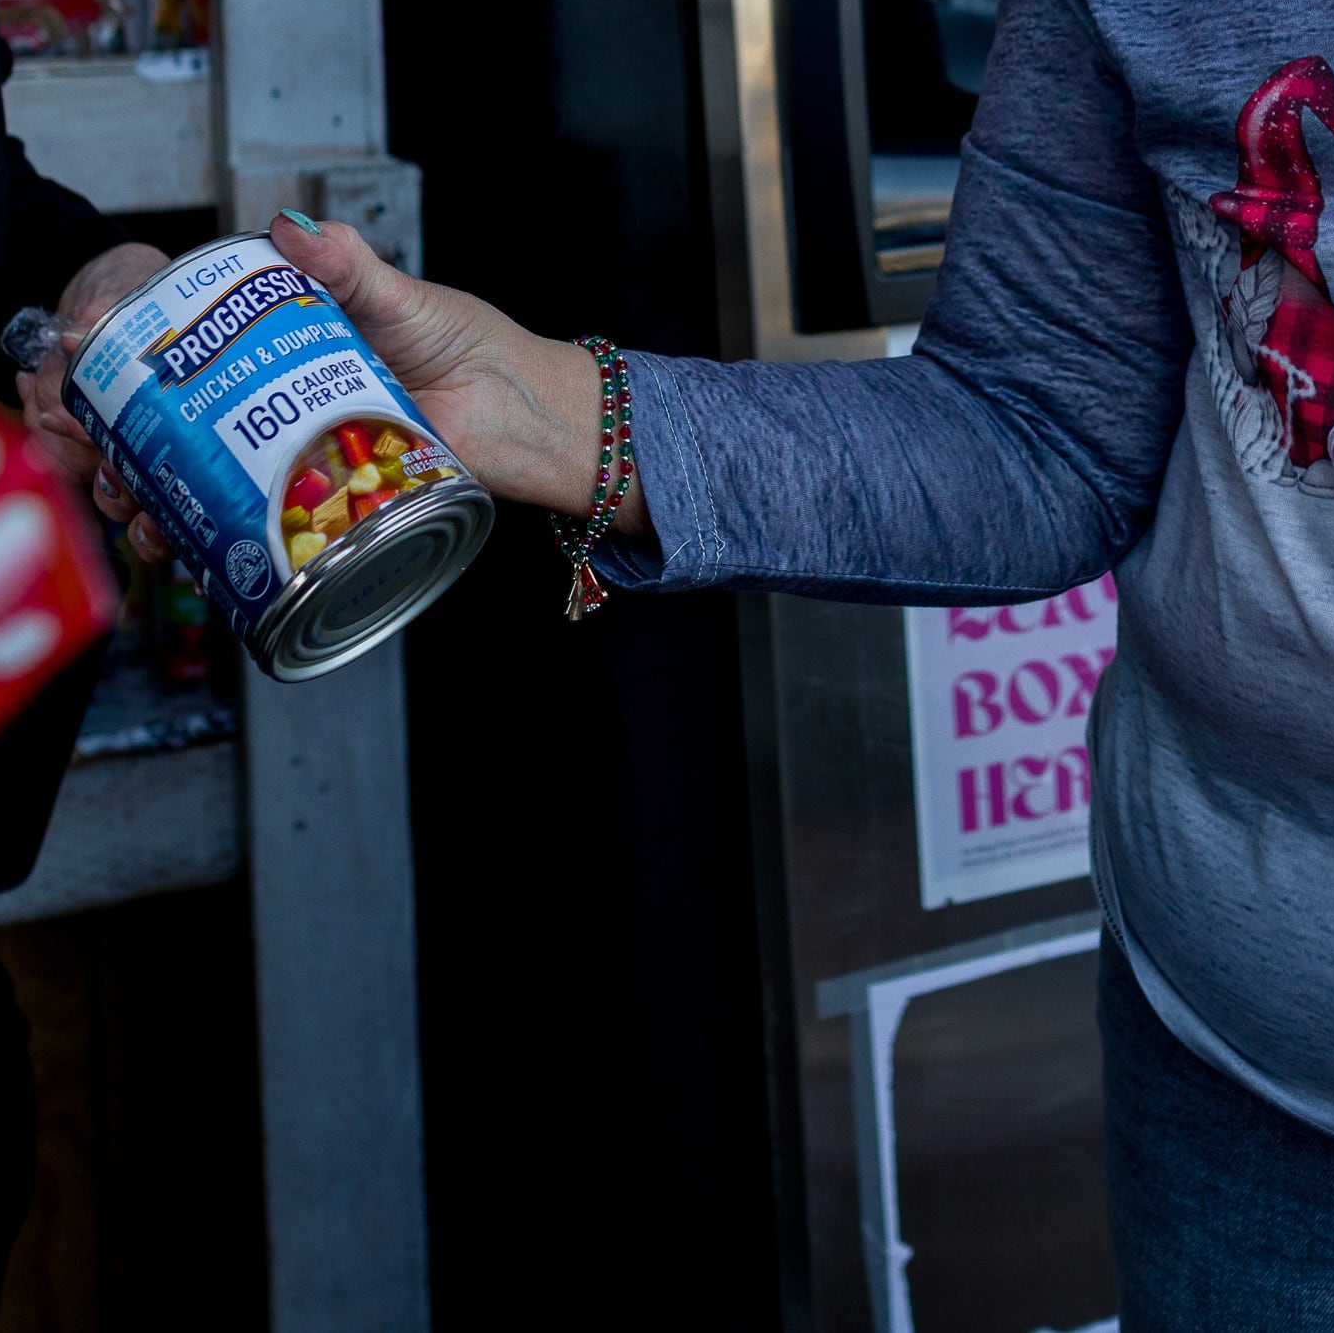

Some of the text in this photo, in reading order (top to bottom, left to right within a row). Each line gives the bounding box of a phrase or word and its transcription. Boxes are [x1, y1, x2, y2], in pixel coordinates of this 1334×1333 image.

[175, 254, 244, 300] LIGHT
[163, 270, 307, 379] PROGRESSO
[179, 321, 354, 424] CHICKEN & DUMPLING
[291, 358, 364, 396] CALORIES
[302, 375, 368, 413] PER CAN
[232, 391, 301, 451] 160
